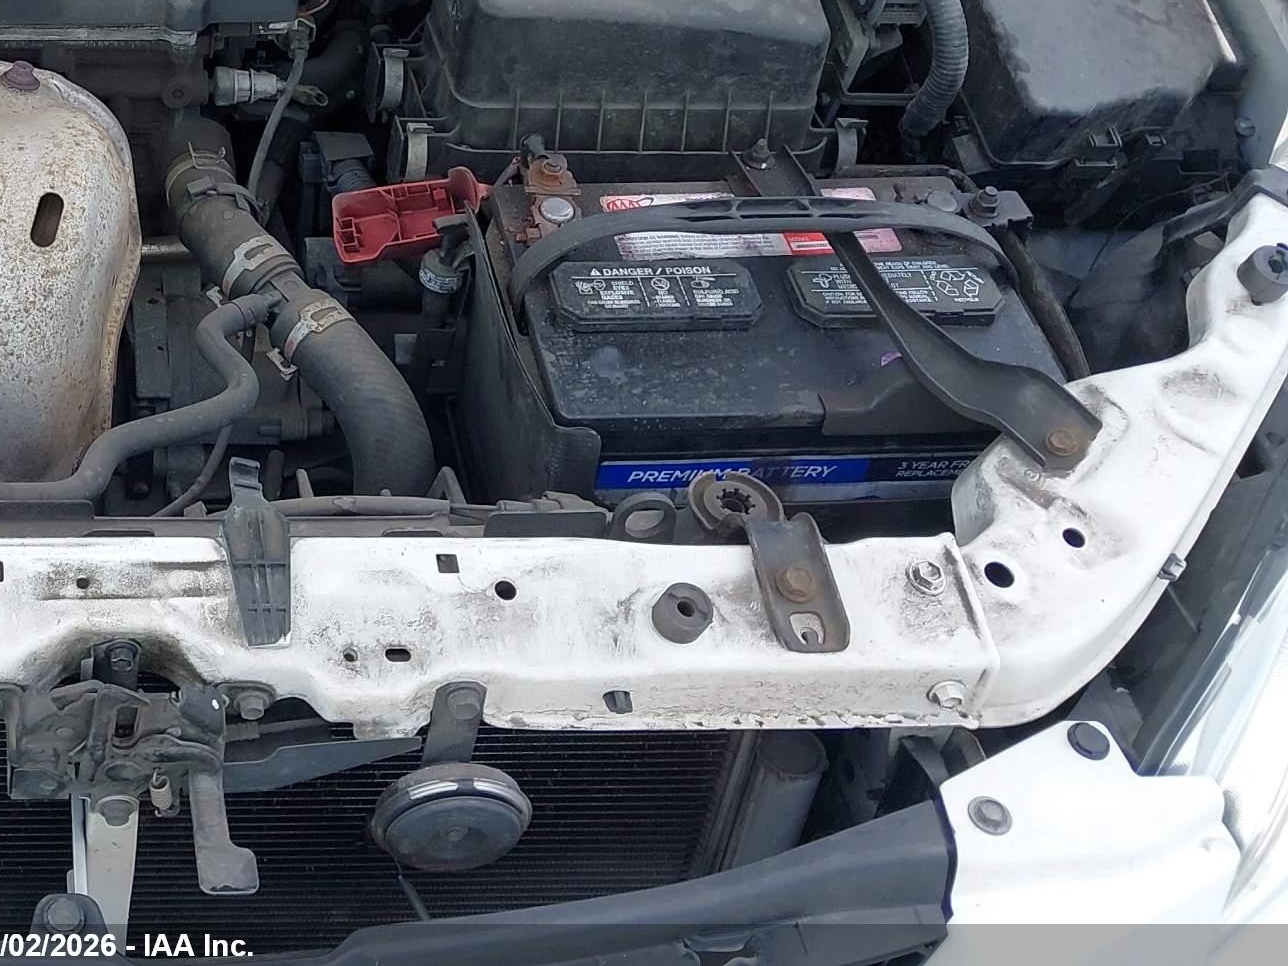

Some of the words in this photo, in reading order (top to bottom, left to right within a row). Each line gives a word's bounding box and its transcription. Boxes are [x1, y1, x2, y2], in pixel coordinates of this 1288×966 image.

[602, 268, 654, 276] DANGER
[665, 266, 711, 275] POISON
[898, 461, 909, 469] 3
[911, 460, 949, 469] YEAR
